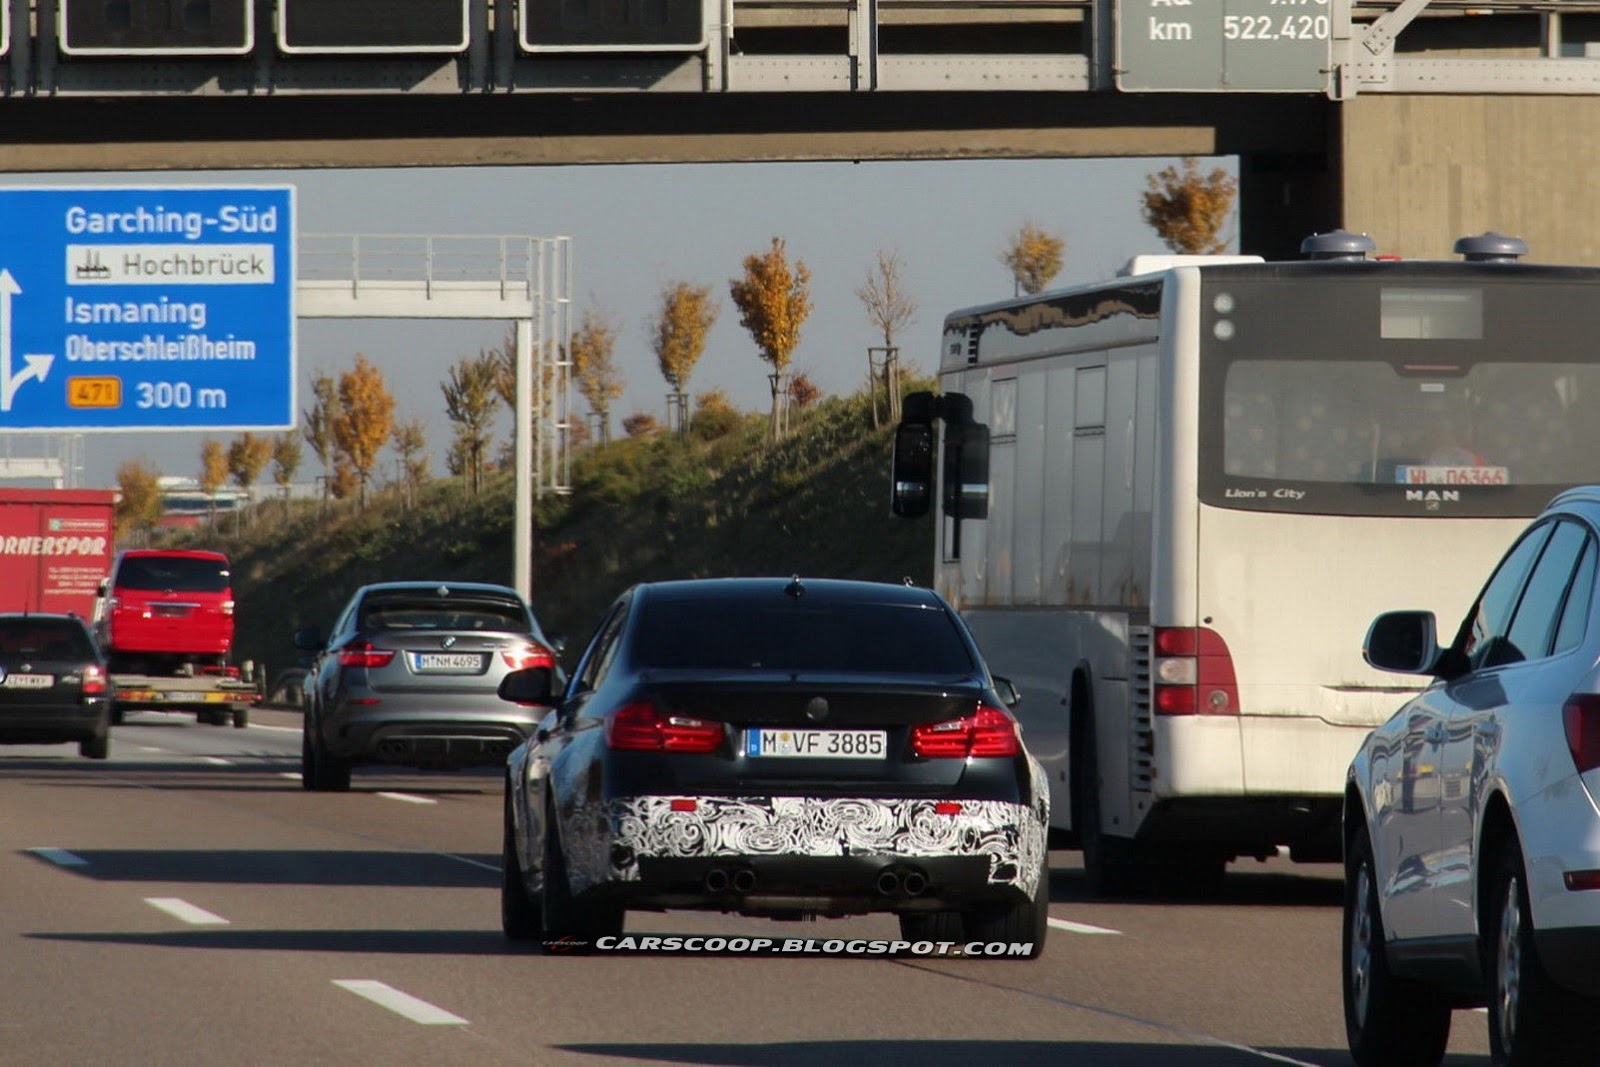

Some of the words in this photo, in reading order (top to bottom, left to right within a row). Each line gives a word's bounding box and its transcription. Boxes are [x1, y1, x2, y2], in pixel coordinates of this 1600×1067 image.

[1149, 16, 1193, 40] km
[1224, 15, 1329, 40] 522.420
[65, 206, 278, 239] Garching-Süd
[124, 253, 265, 276] Hochbrück
[66, 296, 207, 329] Ismaning
[65, 334, 256, 361] Oberschleißheim
[77, 382, 113, 401] 471
[136, 382, 192, 408] 300
[198, 388, 227, 408] m
[1225, 488, 1268, 498] Lion's
[1273, 488, 1306, 500] City
[1406, 490, 1459, 501] MAN
[762, 732, 777, 752] M
[793, 733, 820, 753] VF
[827, 733, 882, 754] 3885
